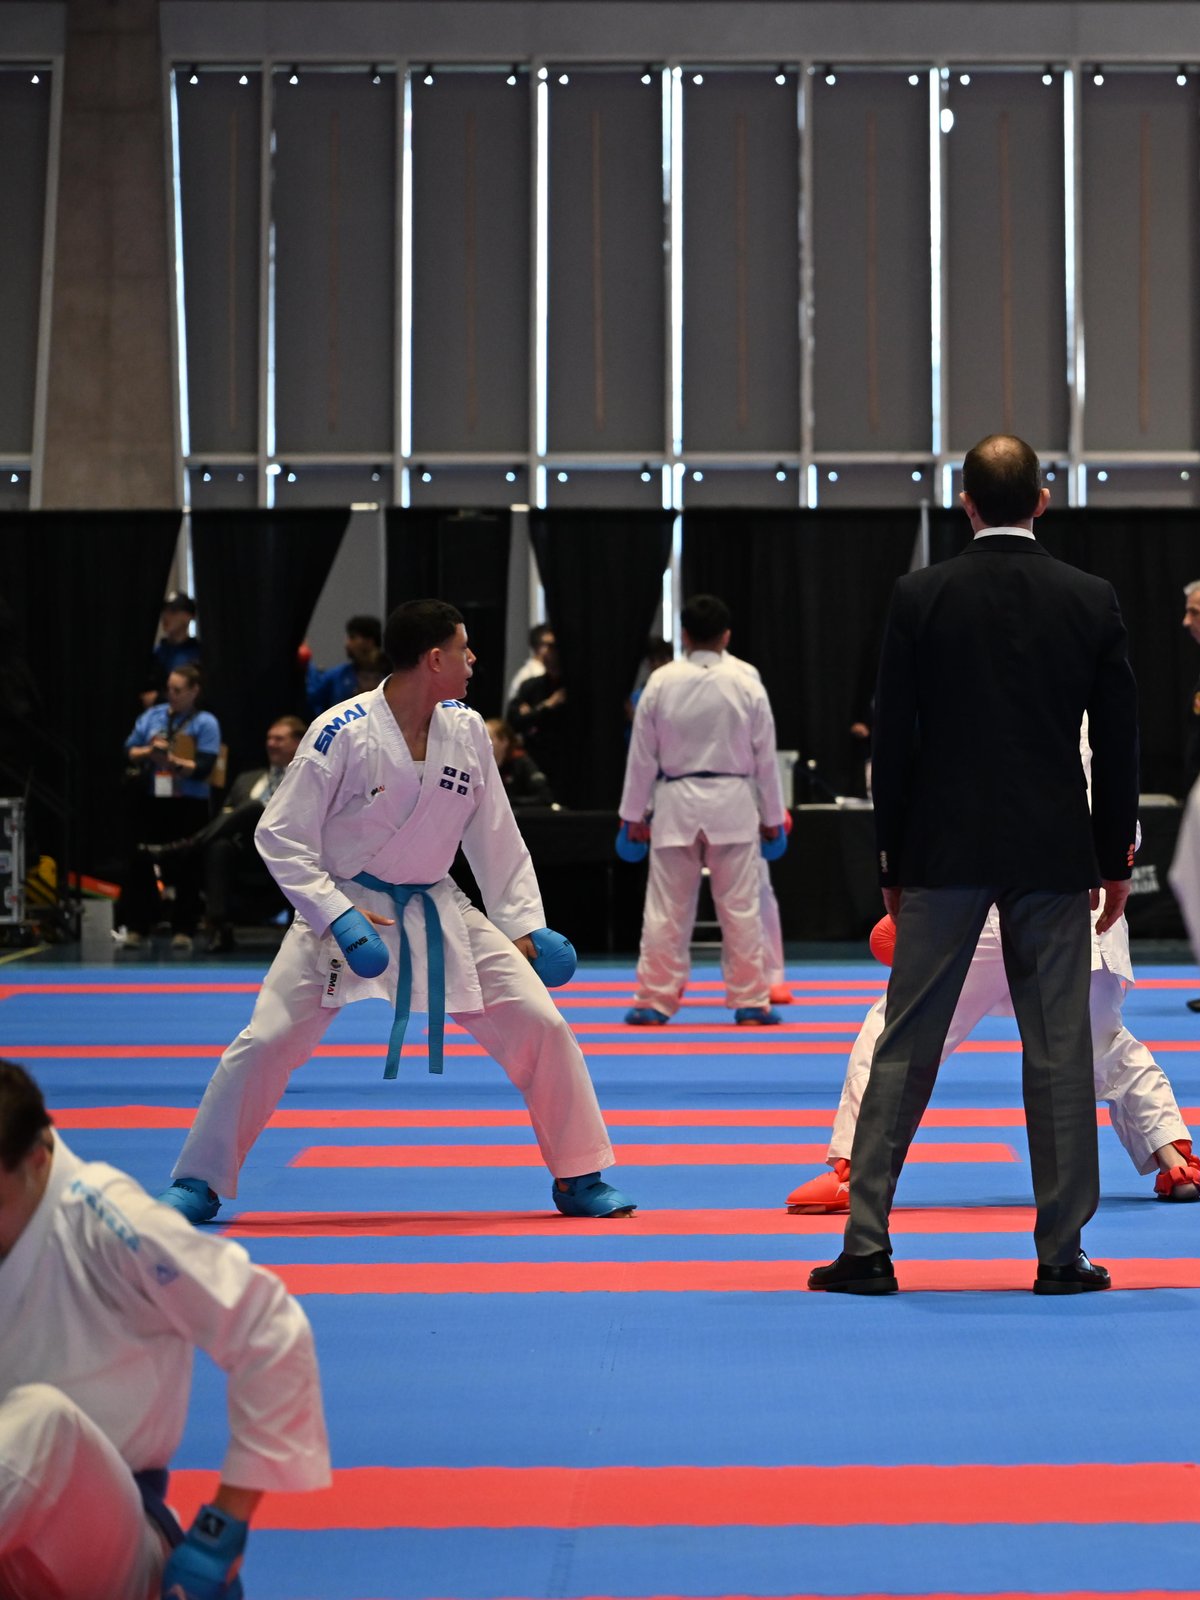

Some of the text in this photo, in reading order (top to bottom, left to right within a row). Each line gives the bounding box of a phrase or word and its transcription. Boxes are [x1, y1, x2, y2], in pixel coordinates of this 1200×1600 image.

[314, 703, 367, 756] SMAI
[345, 936, 369, 954] SMAI
[327, 972, 338, 996] SMAI
